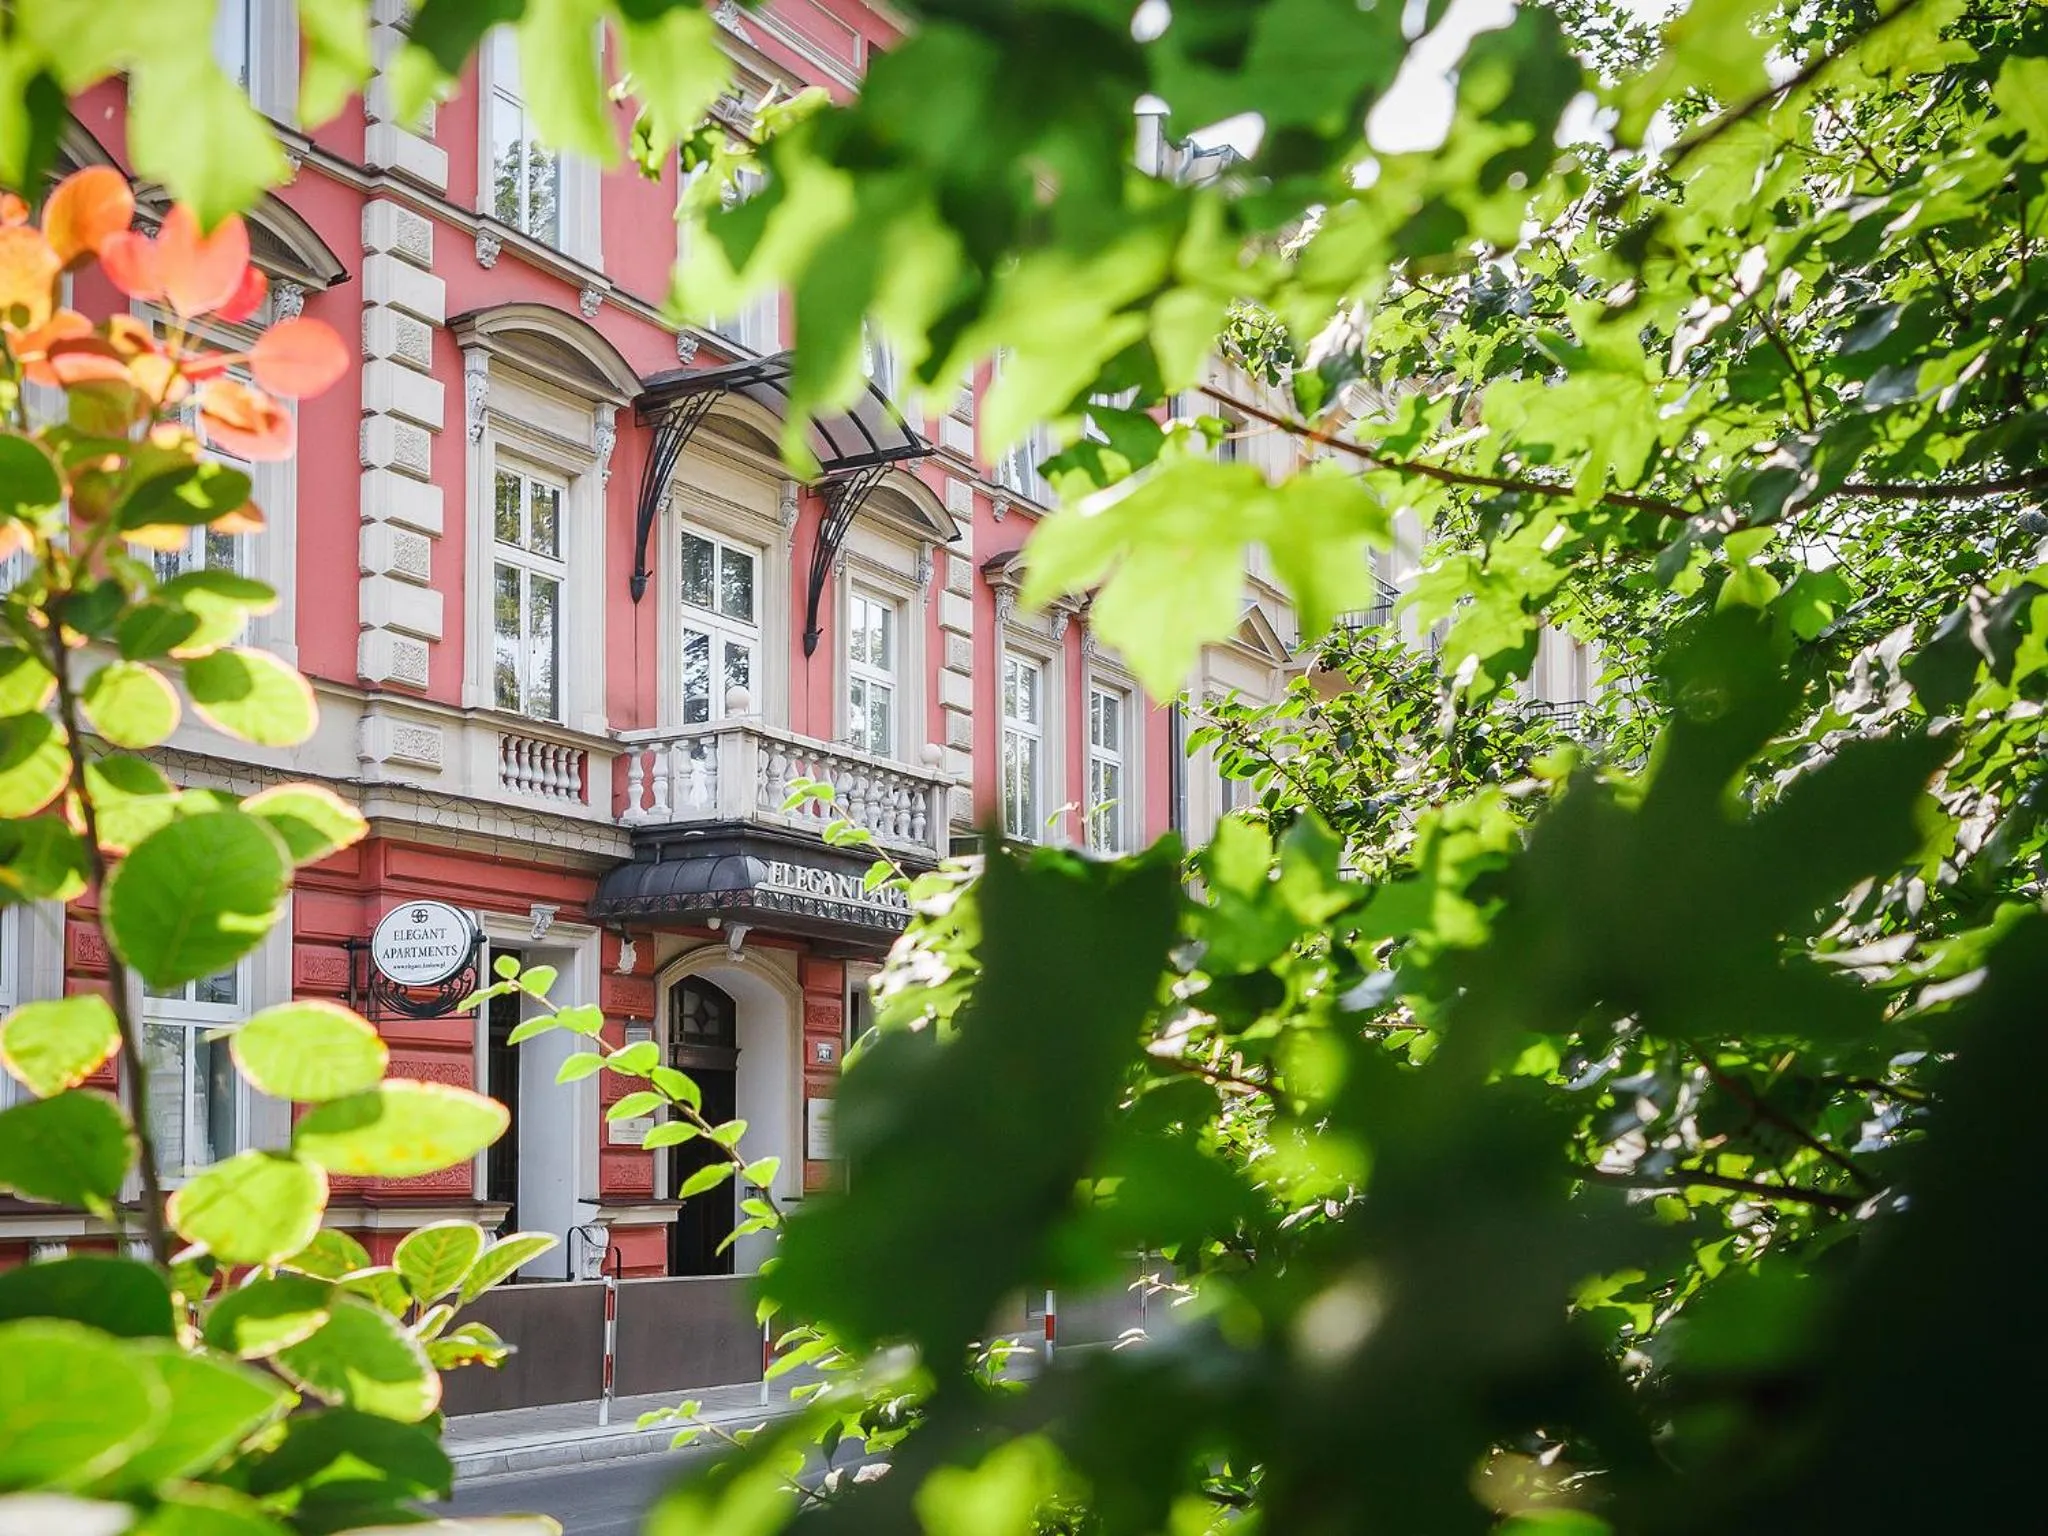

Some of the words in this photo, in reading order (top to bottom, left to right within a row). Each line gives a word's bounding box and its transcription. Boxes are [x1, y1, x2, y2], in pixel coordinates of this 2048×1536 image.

[769, 860, 865, 901] ELEGANT
[394, 928, 447, 941] ELEGANT
[383, 944, 458, 959] APARTMENTS
